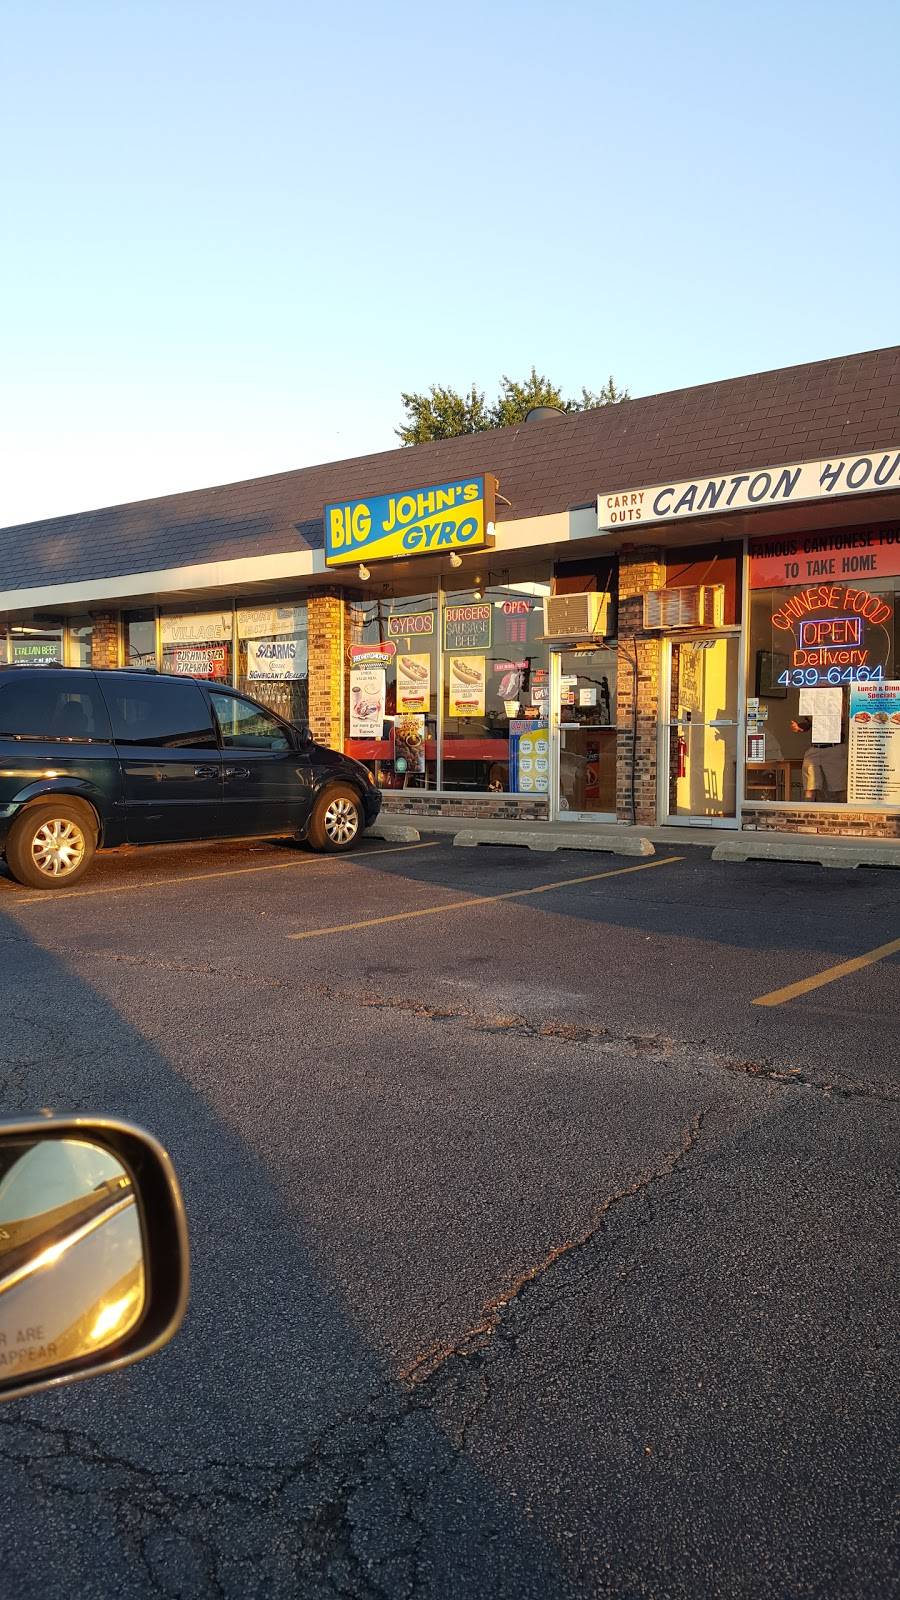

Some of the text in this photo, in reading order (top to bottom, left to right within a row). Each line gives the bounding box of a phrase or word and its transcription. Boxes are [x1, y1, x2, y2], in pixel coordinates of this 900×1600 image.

[652, 453, 900, 516] CANTON HOU
[606, 492, 645, 509] CARRY
[330, 484, 479, 549] BIG JOHN'S
[610, 508, 642, 523] OUTS
[402, 517, 479, 550] GYRO
[751, 540, 798, 559] FAMOUS
[803, 530, 875, 554] CANTONESE
[784, 554, 878, 578] TO TAKE HOME
[446, 606, 490, 622] BURGERS
[503, 600, 531, 615] OPEN
[772, 586, 891, 630] CHINESE FOOD
[172, 624, 223, 641] VILLAGE
[390, 616, 432, 634] GYROS
[446, 621, 488, 636] SAUSAGE
[803, 620, 858, 645] OPEN
[455, 635, 479, 648] BEEF
[692, 640, 716, 649] 1727
[14, 645, 57, 656] ITALIAN BEEF
[177, 649, 224, 661] BUSHMASTER
[256, 643, 297, 659] SIGARMS
[793, 649, 869, 667] Delivery
[177, 662, 214, 673] FIREARMS
[777, 664, 885, 687] 439-6464
[16, 1325, 45, 1344] ARE
[0, 1343, 58, 1366] APPEAR
